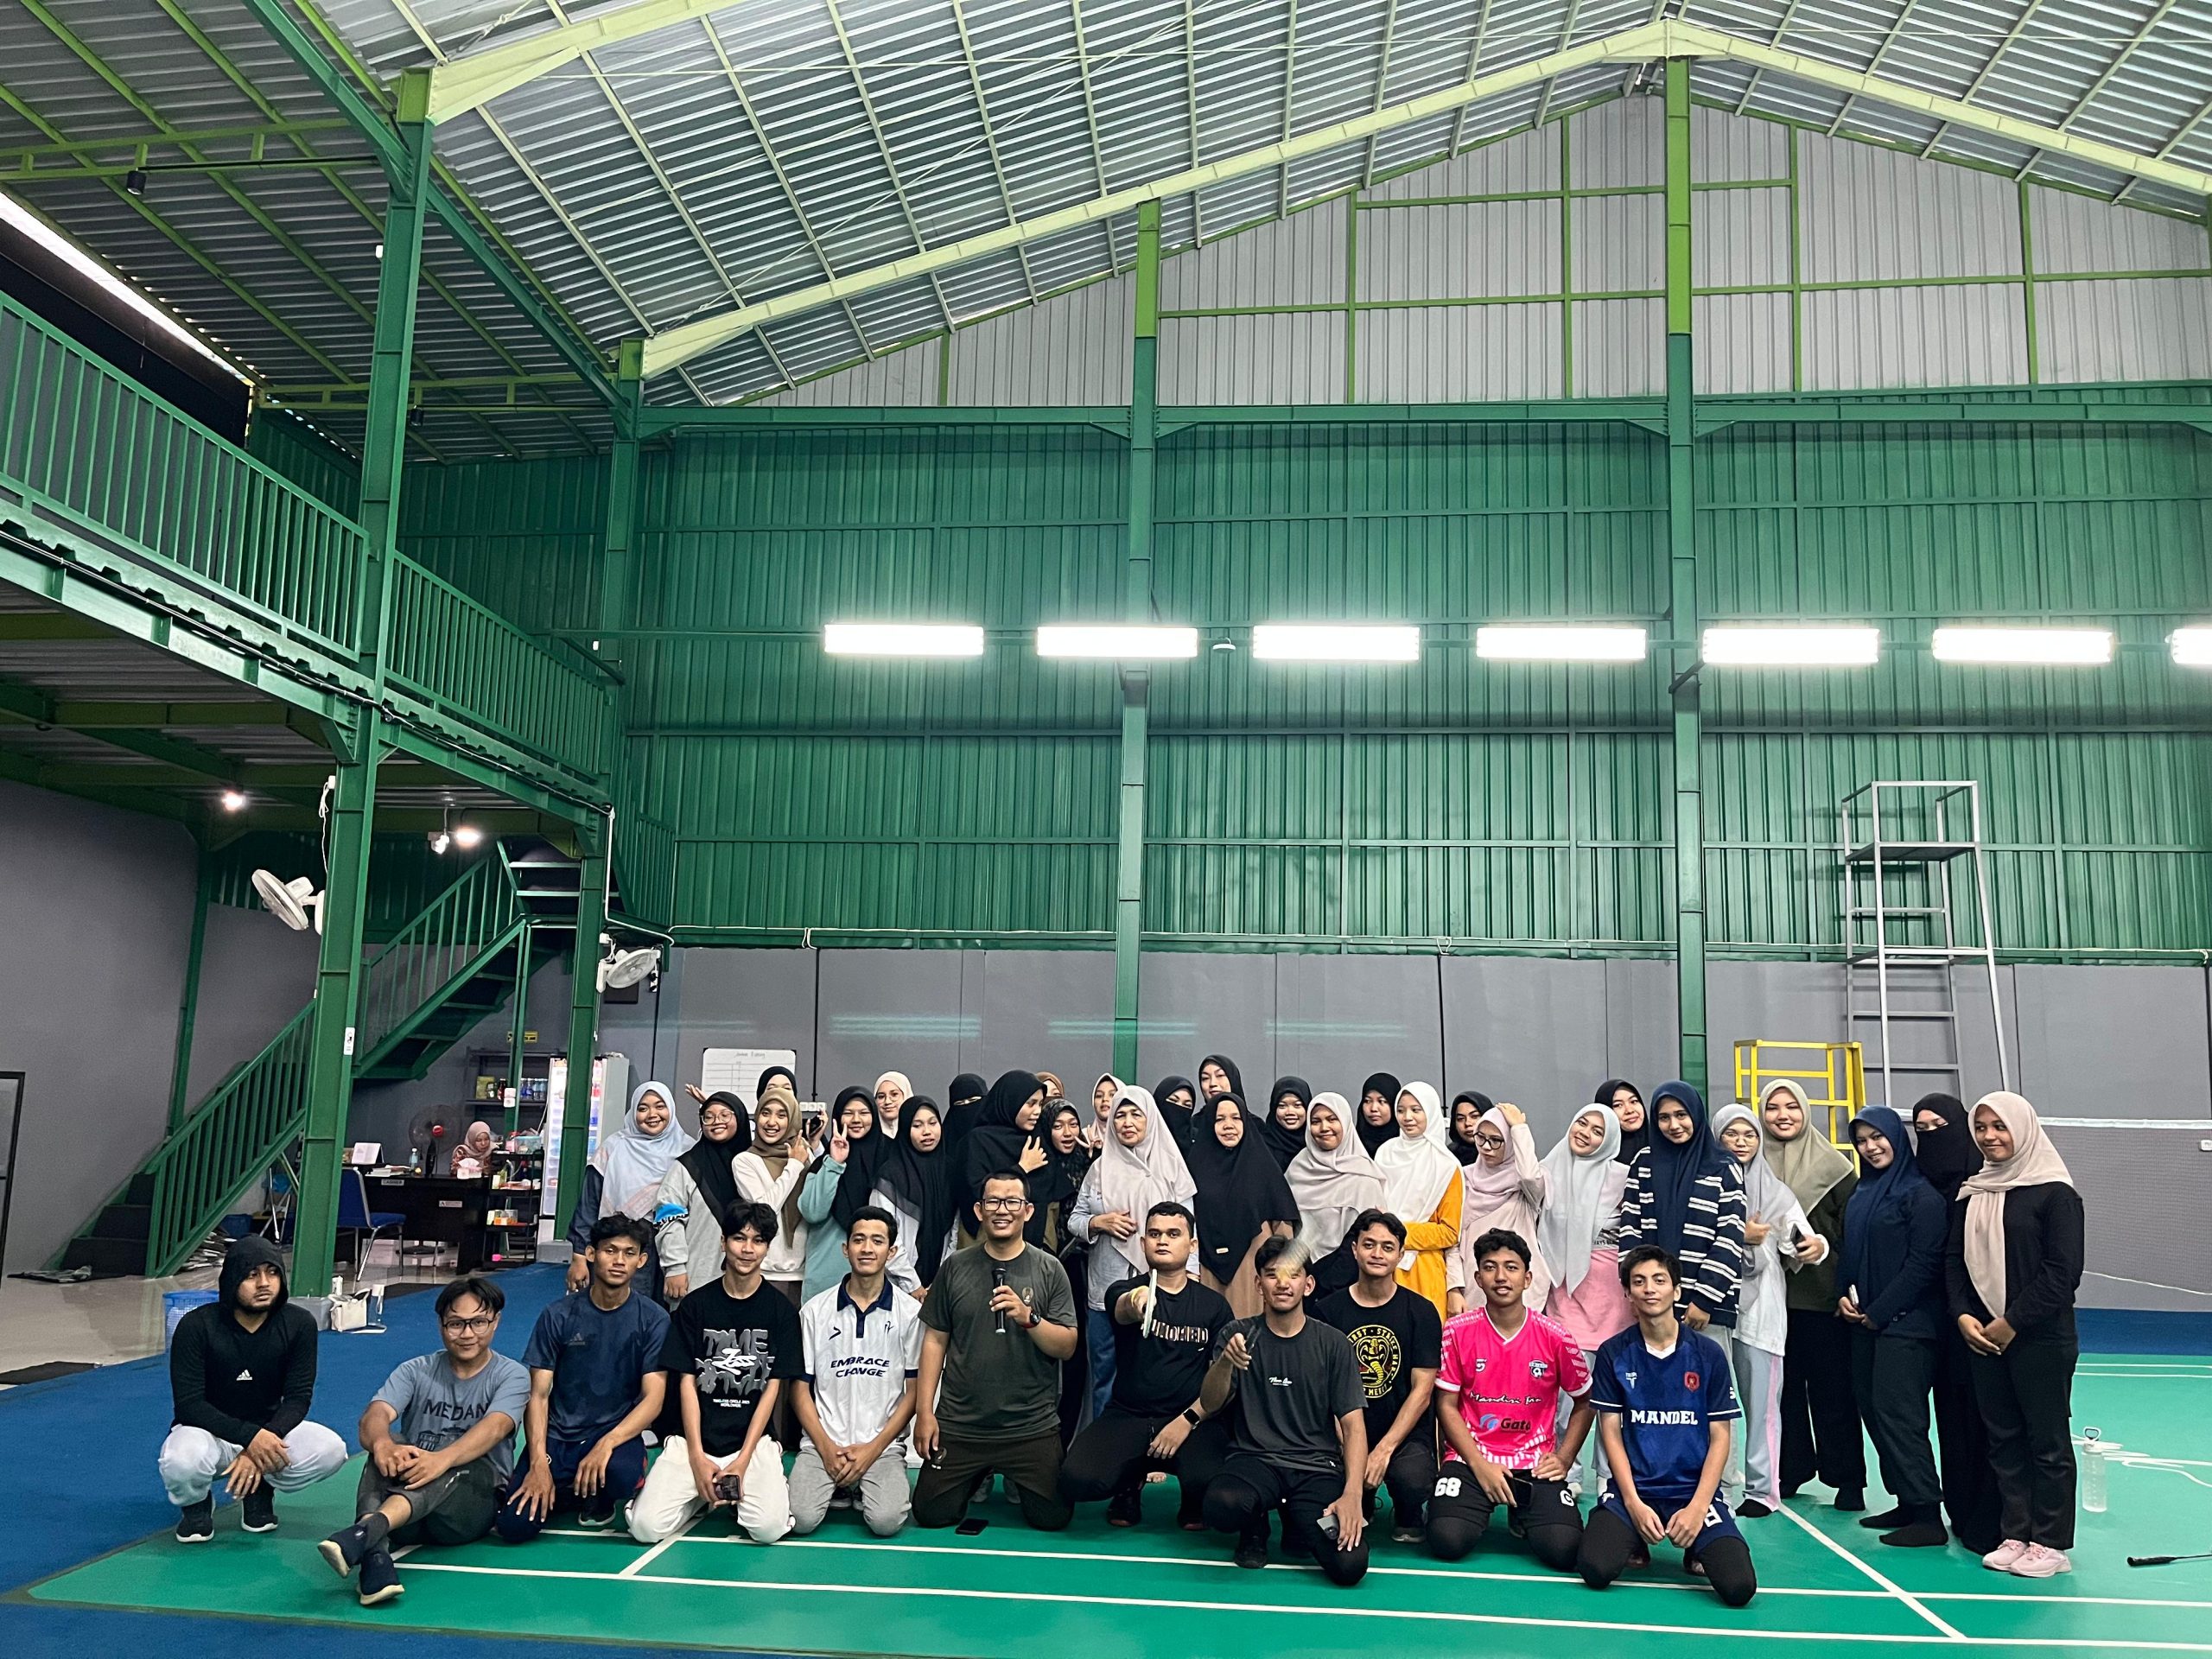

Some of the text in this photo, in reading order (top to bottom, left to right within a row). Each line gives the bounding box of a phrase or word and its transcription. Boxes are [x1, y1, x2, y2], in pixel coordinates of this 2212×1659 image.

[830, 1357, 890, 1369] EMBRACE
[423, 1399, 489, 1421] MEDAN
[1630, 1409, 1699, 1426] MANDEL
[1434, 1477, 1462, 1497] 68
